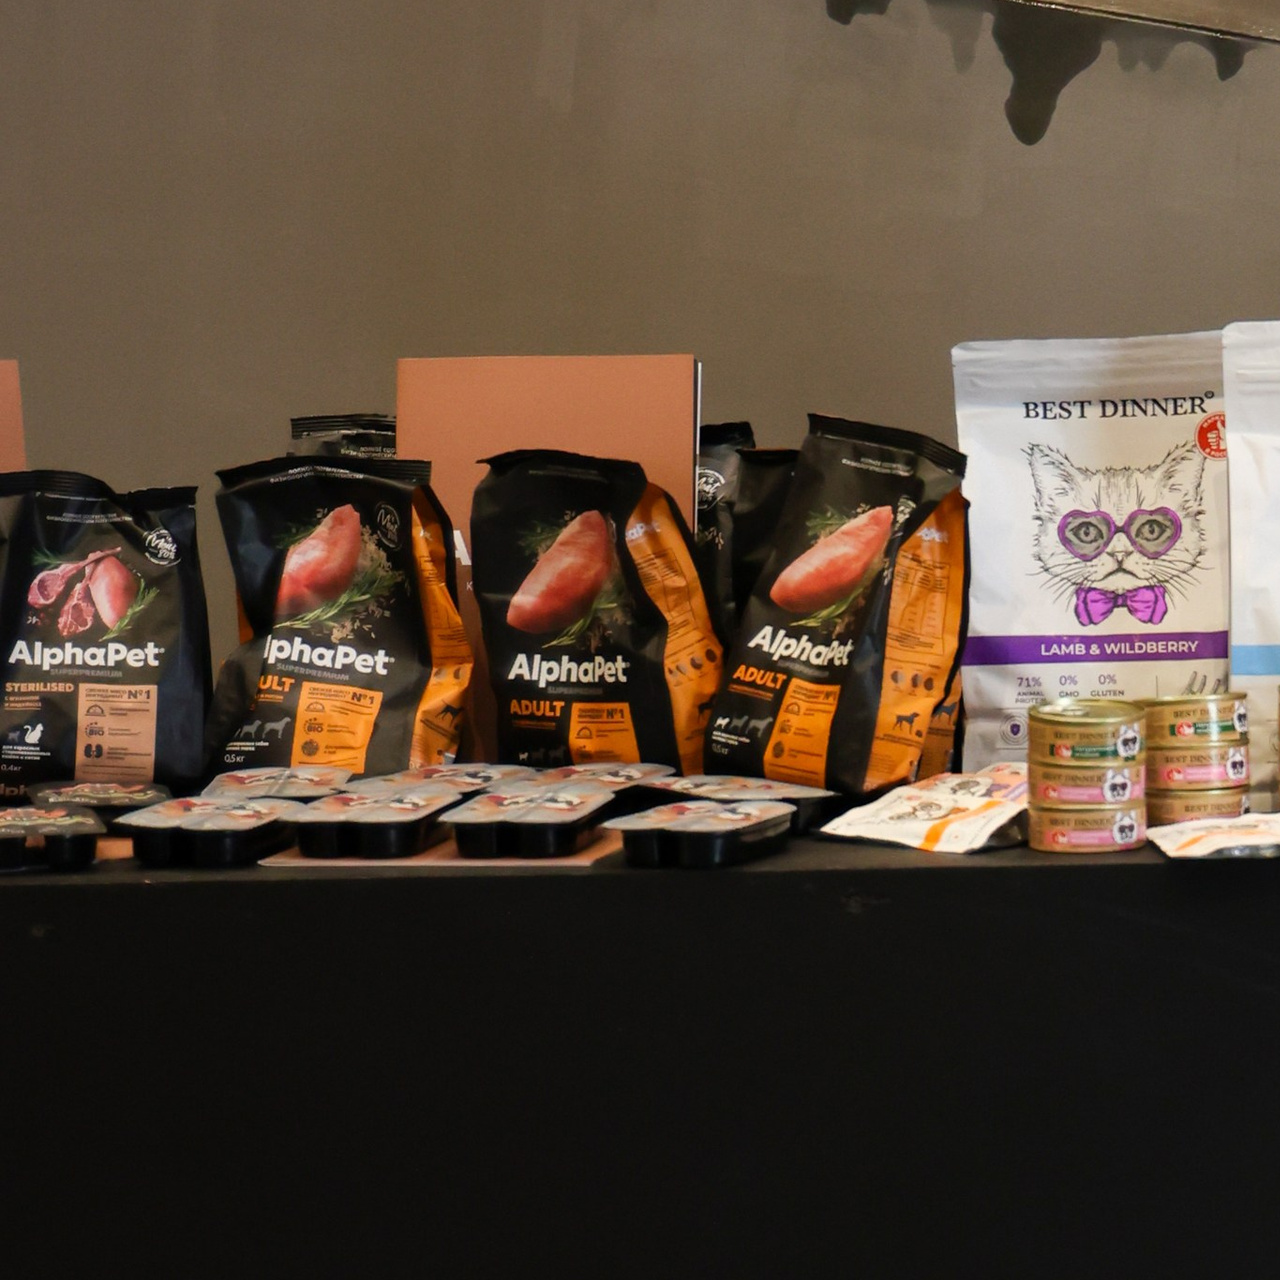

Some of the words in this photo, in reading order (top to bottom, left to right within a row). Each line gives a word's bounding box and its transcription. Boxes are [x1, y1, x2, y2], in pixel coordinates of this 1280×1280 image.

[1023, 400, 1091, 420] BEST
[1099, 395, 1208, 419] DINNER
[8, 640, 160, 670] AlphaPet
[263, 634, 388, 675] lphaPet
[748, 625, 853, 666] AlphaPet
[1041, 643, 1086, 656] LAMB
[1089, 643, 1100, 655] &
[1104, 640, 1199, 655] WILDBERRY
[507, 653, 628, 688] AlphaPet
[733, 665, 788, 690] ADULT
[1016, 676, 1042, 688] 71%
[1059, 675, 1078, 686] 0%
[1098, 673, 1117, 685] 0%
[5, 682, 75, 693] STERILISED
[1059, 690, 1079, 698] GMO
[1090, 689, 1125, 697] GLUTEN
[510, 699, 565, 717] ADULT
[1173, 710, 1197, 719] BEST
